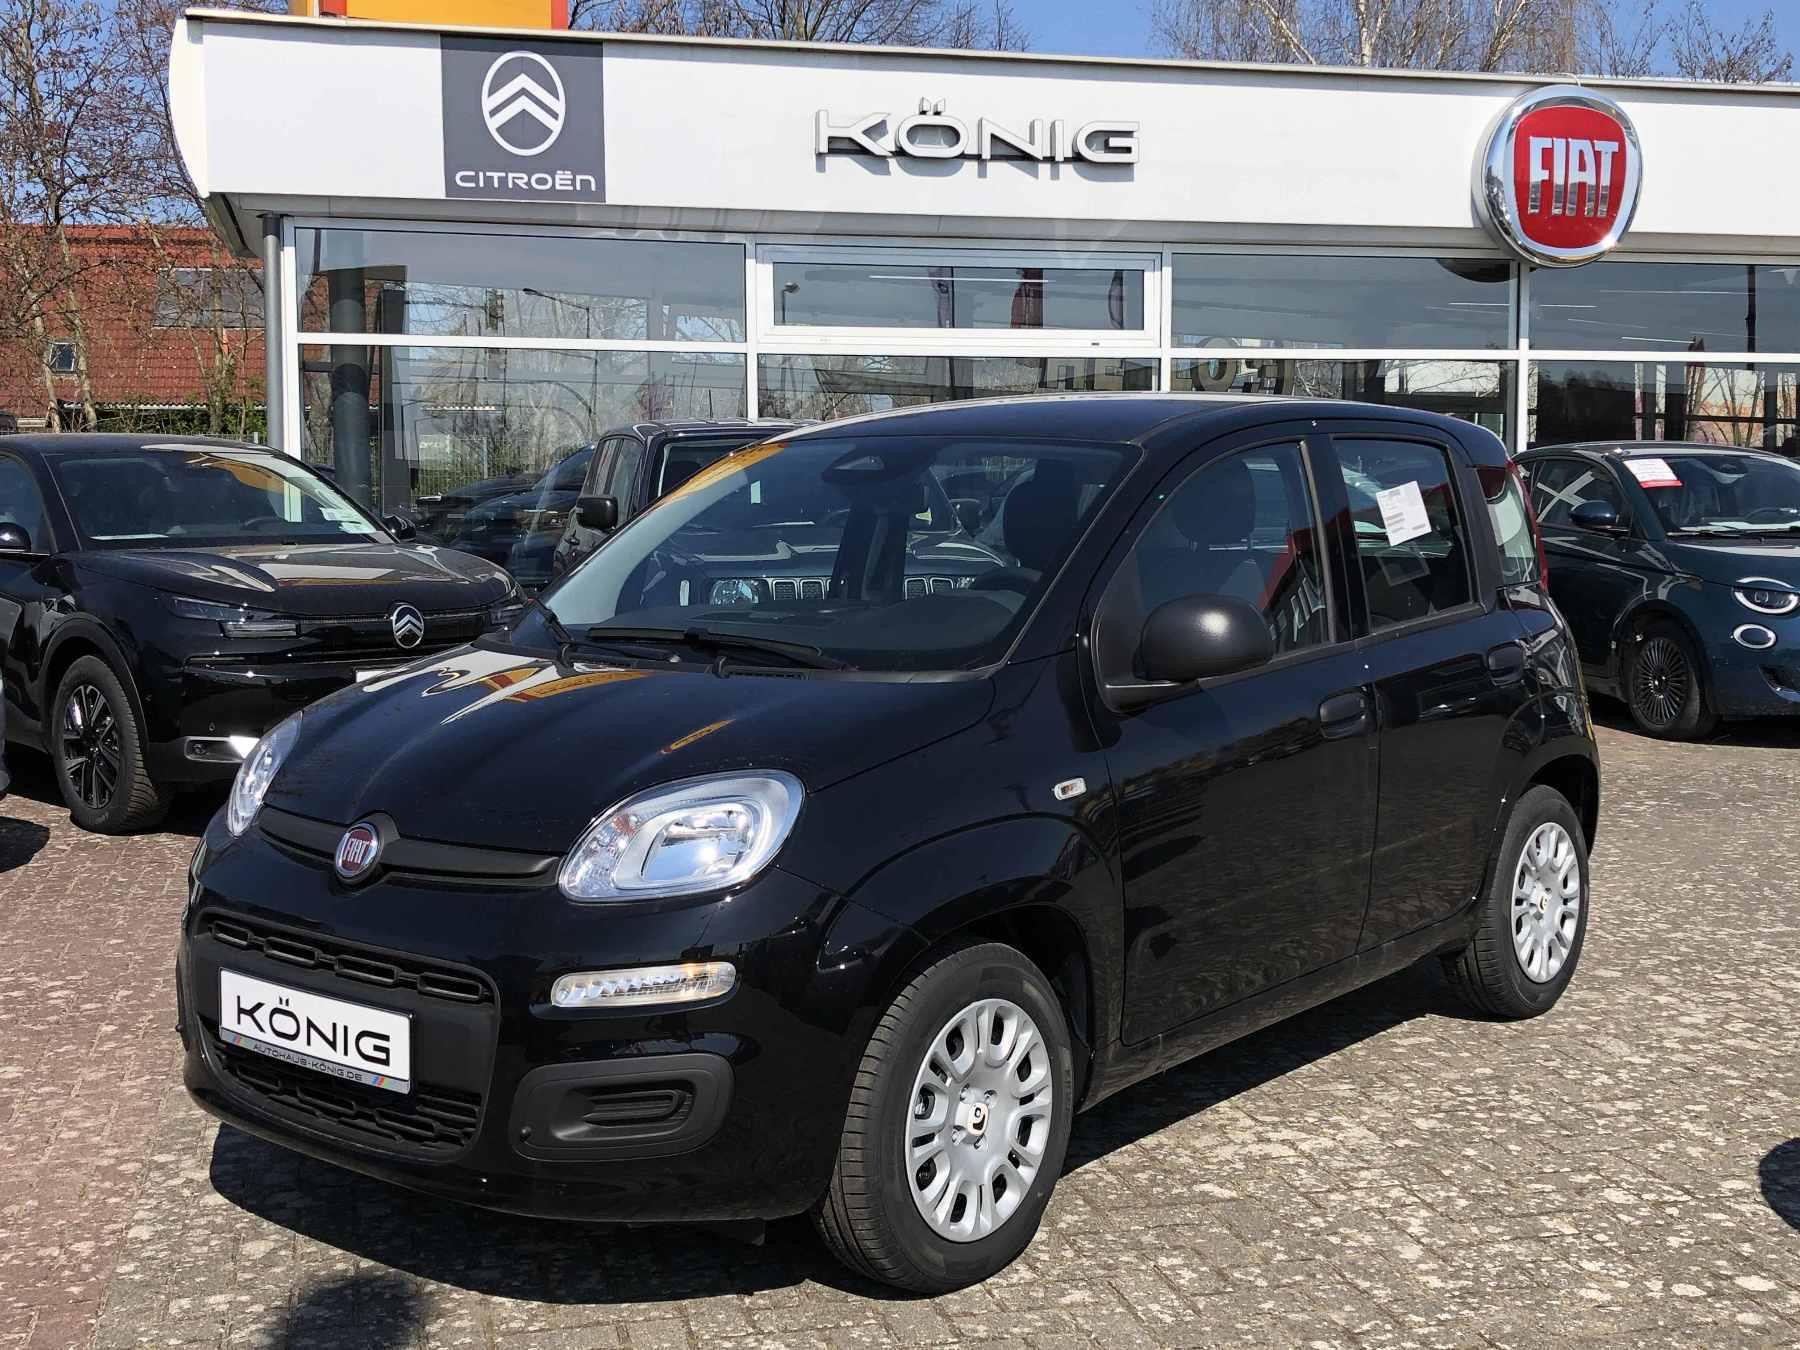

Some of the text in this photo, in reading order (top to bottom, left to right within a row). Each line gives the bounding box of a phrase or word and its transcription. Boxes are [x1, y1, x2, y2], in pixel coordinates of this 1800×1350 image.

[816, 97, 1140, 163] KÖNIG
[1528, 135, 1619, 217] FIAT
[342, 838, 370, 864] FIAT
[236, 995, 391, 1067] KÖNIG
